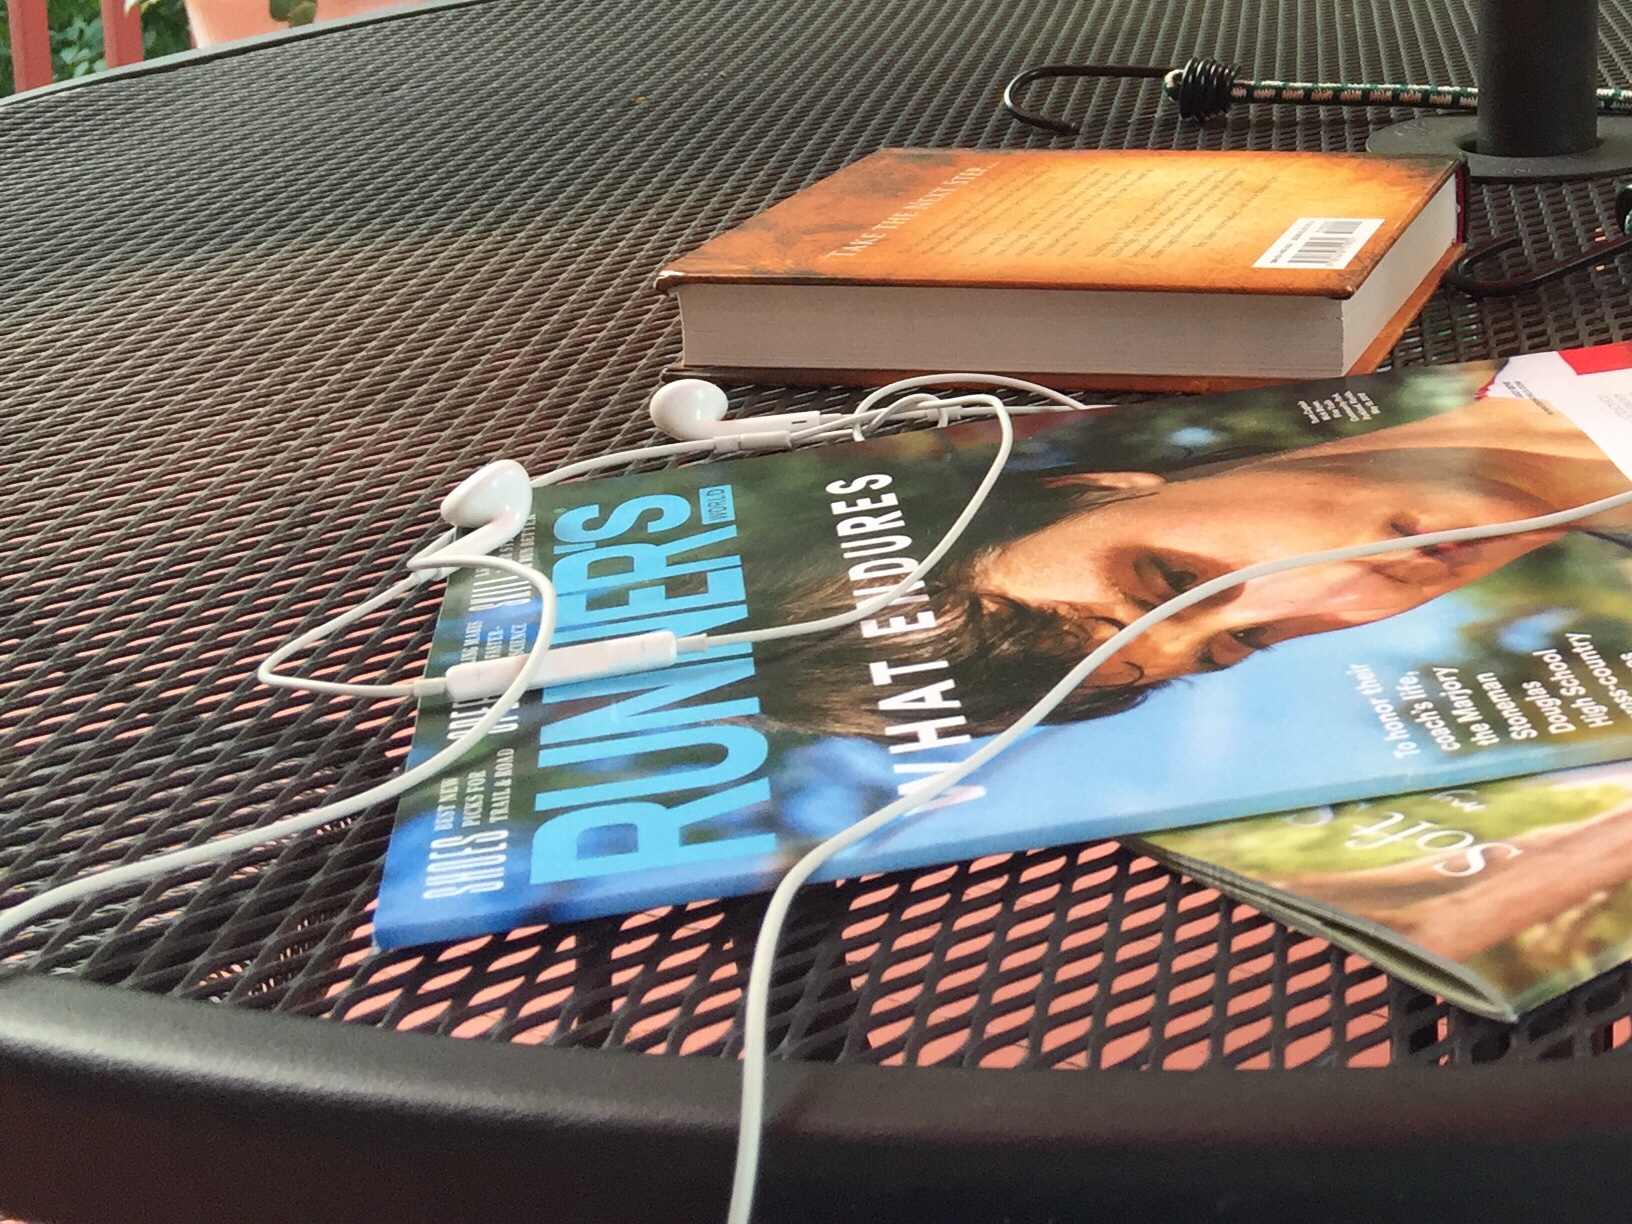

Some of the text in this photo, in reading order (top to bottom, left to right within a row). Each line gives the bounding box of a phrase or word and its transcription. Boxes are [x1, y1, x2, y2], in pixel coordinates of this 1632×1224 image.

[825, 232, 887, 258] TAKE
[872, 212, 919, 231] THE
[902, 186, 957, 210] NEXT
[706, 487, 727, 525] WORLD
[463, 620, 484, 645] MAKES
[825, 473, 987, 818] WHAT ENDURES
[1347, 663, 1421, 758] To honor their
[1396, 671, 1428, 701] life,
[1432, 666, 1500, 746] the Marjory
[1476, 672, 1539, 740] Stoneman
[1522, 680, 1577, 735] Douglas
[1532, 648, 1614, 728] High School
[1410, 701, 1461, 752] coach's
[434, 777, 460, 832] BEST NEW
[461, 770, 487, 828] PICKS FOR
[489, 748, 515, 824] TRAIL & ROAD
[422, 829, 510, 900] SHOES
[1344, 810, 1526, 878] Soft
